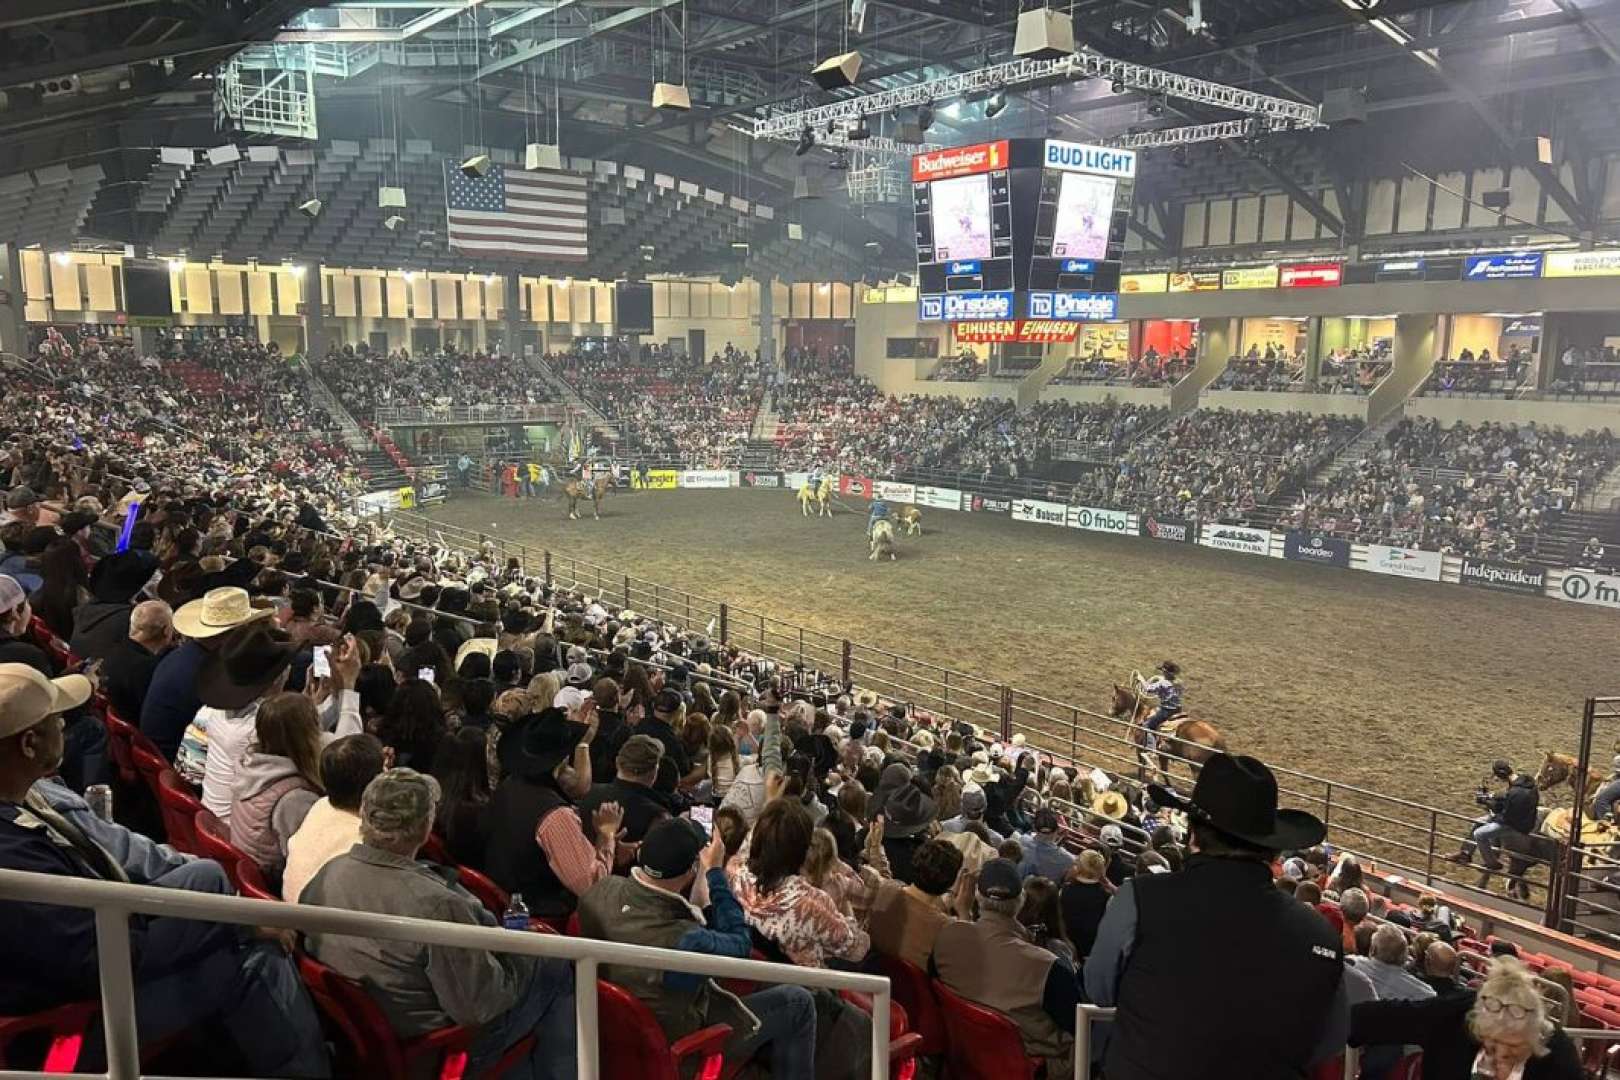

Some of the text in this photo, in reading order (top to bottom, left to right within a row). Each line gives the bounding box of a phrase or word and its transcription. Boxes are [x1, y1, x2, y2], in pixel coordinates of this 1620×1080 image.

[918, 149, 987, 173] Budweiser
[1047, 145, 1133, 173] BUD LIGHT
[945, 293, 1009, 314] Dinsdale
[1056, 292, 1114, 314] Dinsdale
[1036, 508, 1064, 523] Bobcat
[1094, 513, 1125, 531] fnbo
[1463, 560, 1543, 586] Independent
